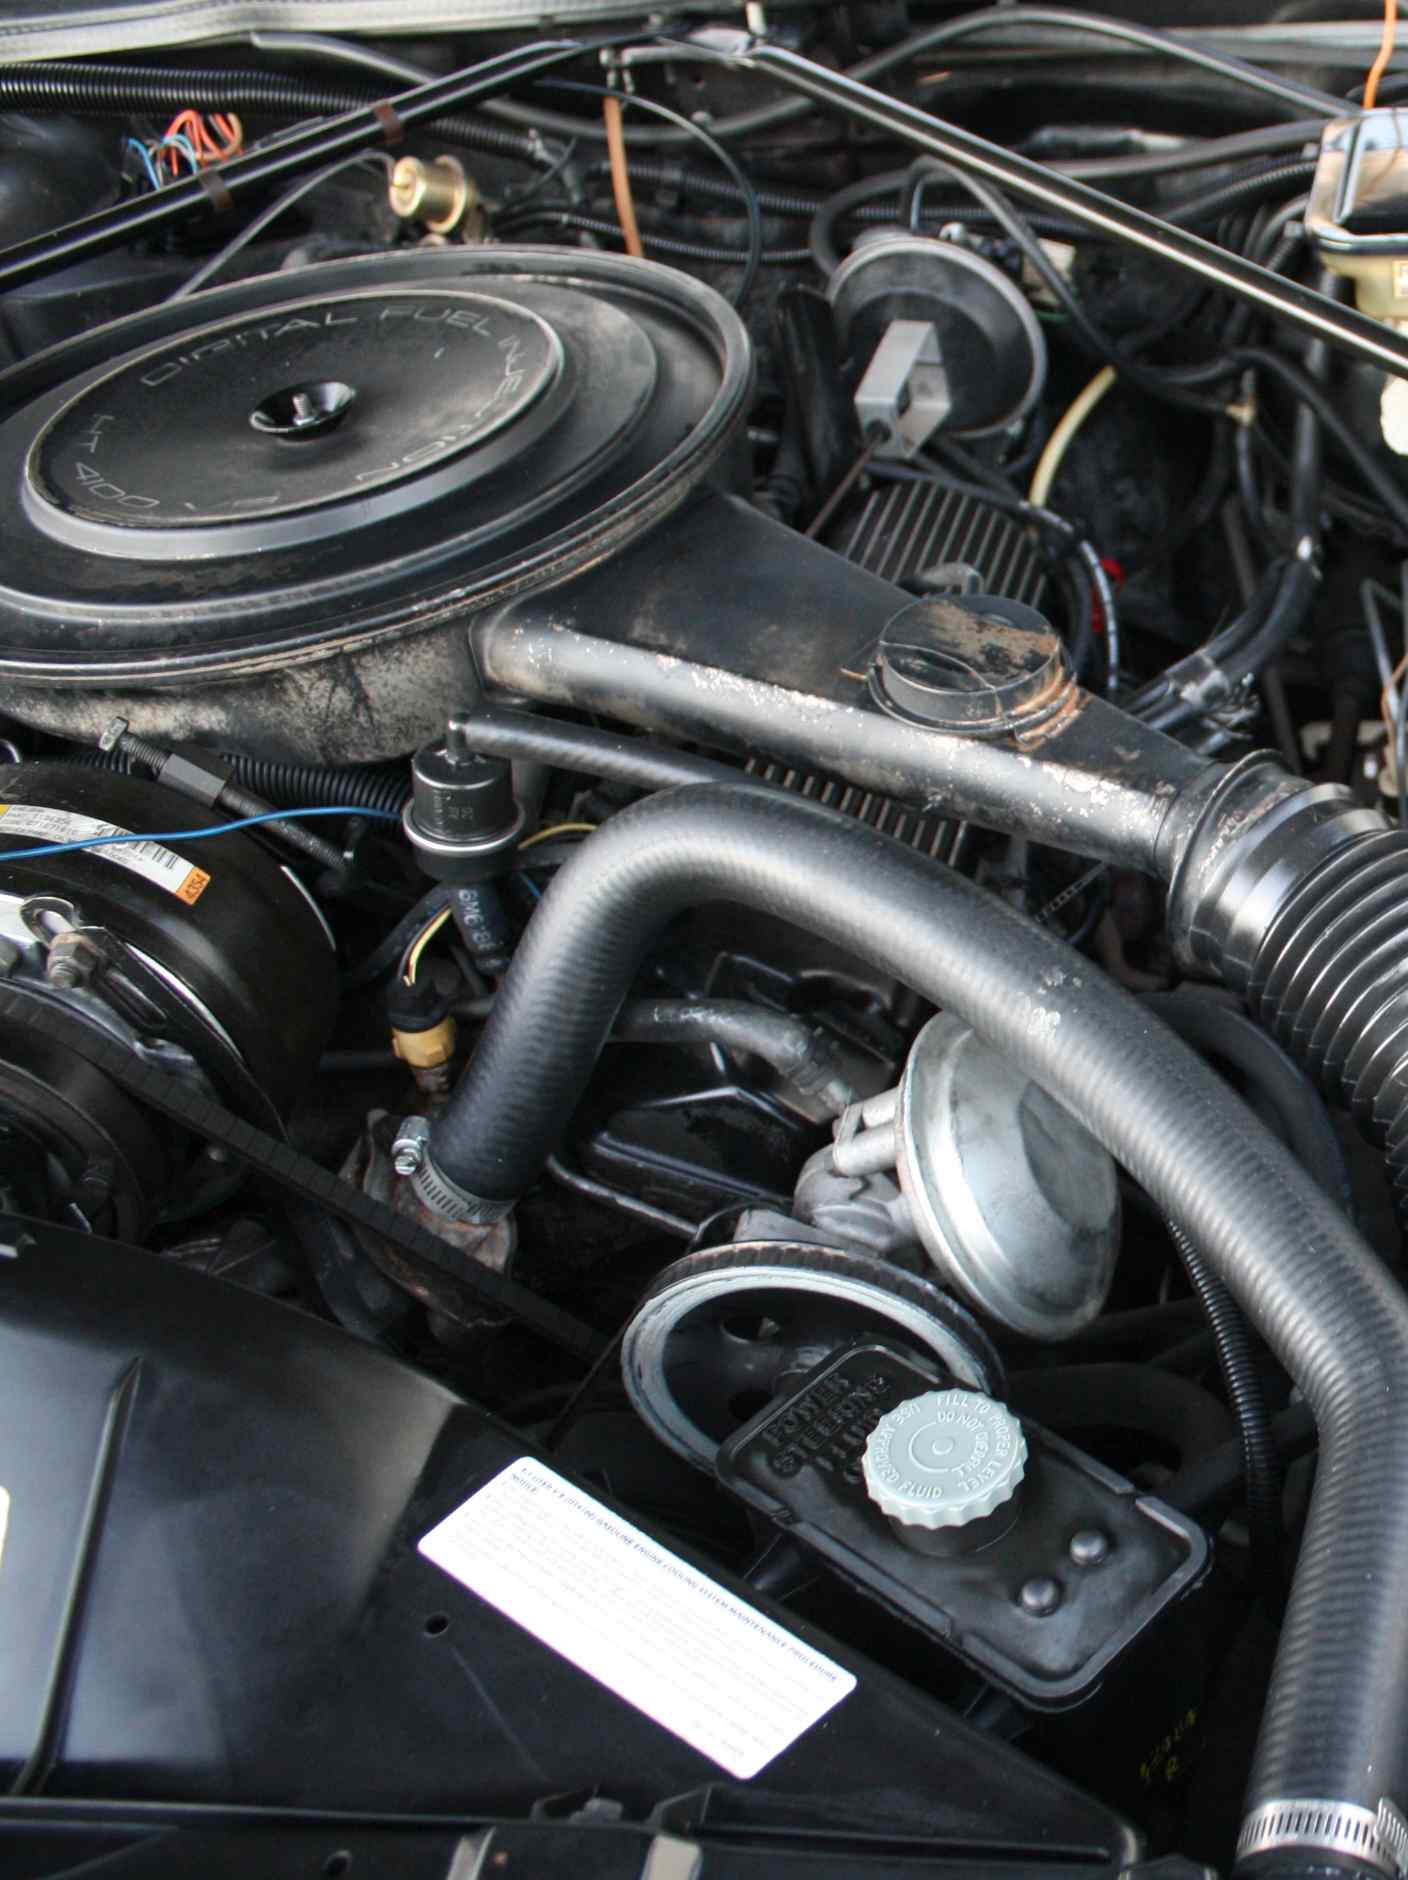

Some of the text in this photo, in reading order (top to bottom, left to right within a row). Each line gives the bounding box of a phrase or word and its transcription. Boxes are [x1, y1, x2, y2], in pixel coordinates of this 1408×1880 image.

[139, 310, 360, 388] DIGITAL
[379, 304, 496, 338] FUEL
[74, 461, 161, 509] 4100
[891, 1402, 922, 1426] USE
[937, 1410, 955, 1423] DO
[957, 1413, 986, 1432] NOT
[937, 1393, 1012, 1492] FILL TO PROPER LEVEL
[897, 1478, 943, 1499] FLUID
